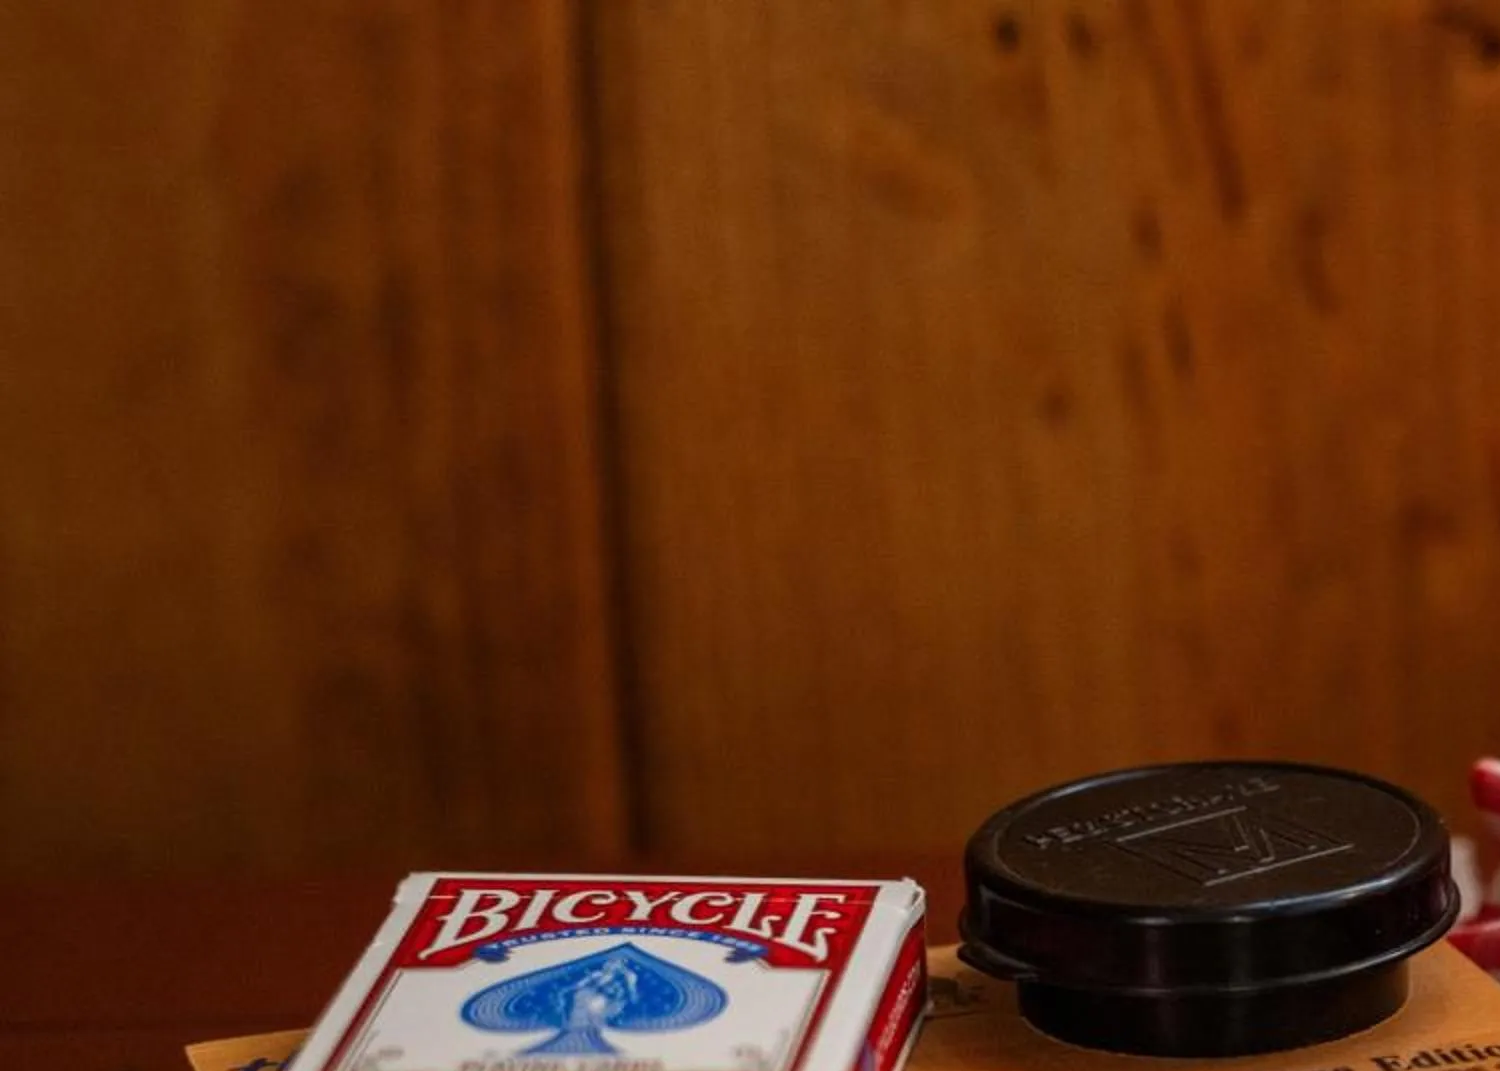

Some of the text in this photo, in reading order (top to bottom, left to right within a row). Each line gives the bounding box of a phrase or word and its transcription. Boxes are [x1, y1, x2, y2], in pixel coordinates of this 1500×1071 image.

[420, 889, 846, 961] BICYCLE
[487, 927, 609, 949] TRUSTED
[621, 927, 700, 938] SINCE
